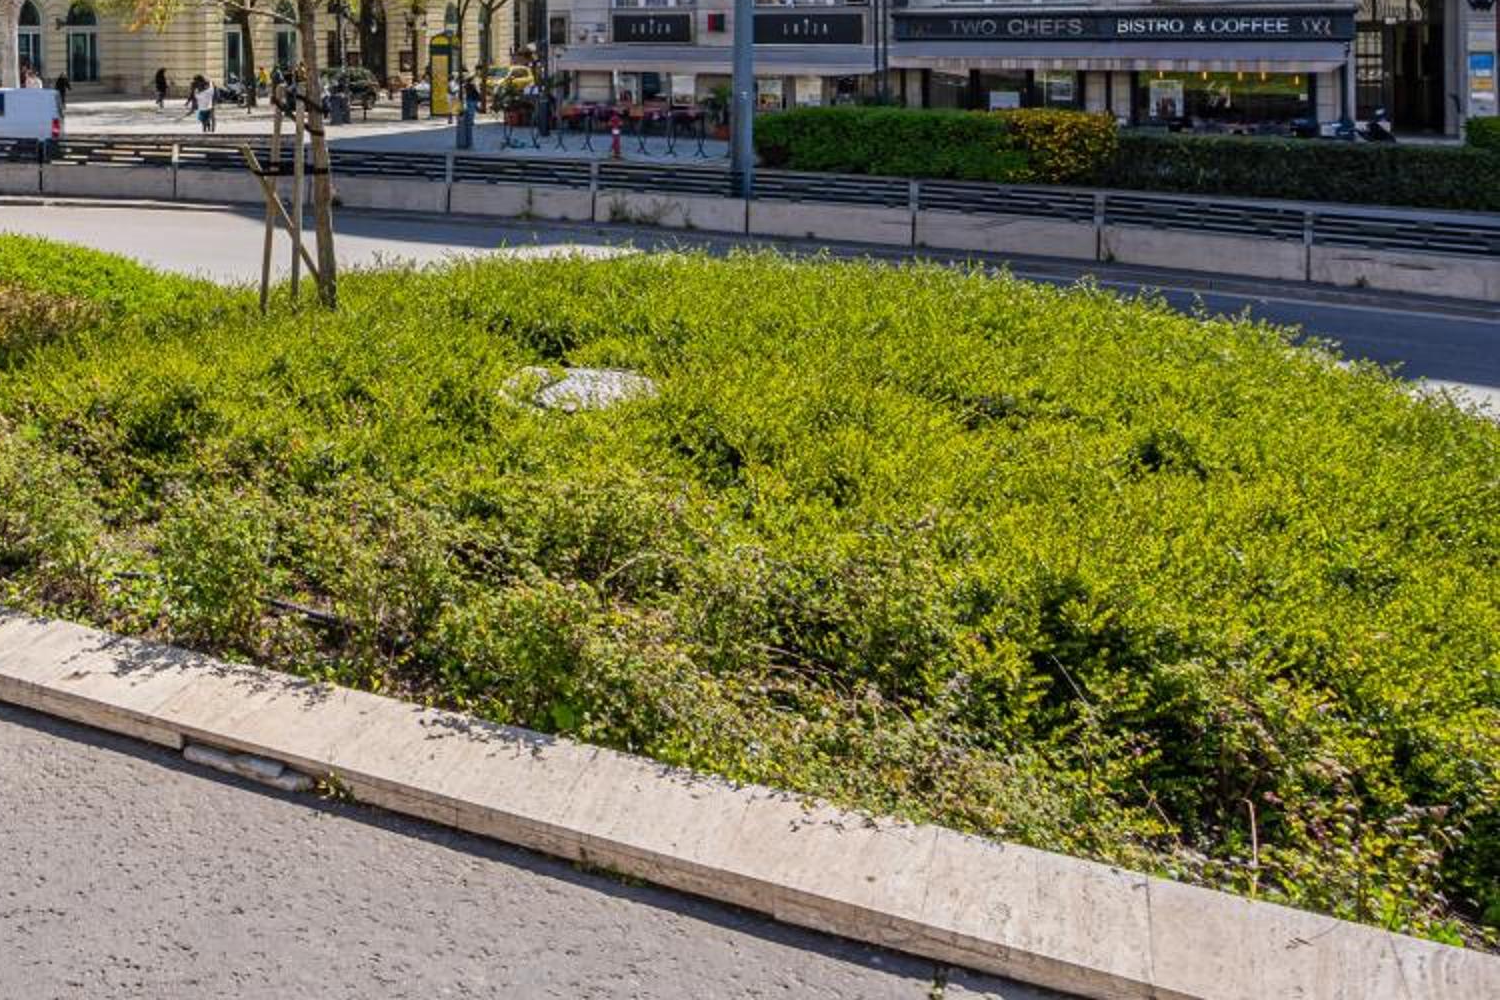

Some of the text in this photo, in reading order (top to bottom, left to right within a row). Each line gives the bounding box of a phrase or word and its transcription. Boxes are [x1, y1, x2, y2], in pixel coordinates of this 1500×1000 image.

[949, 17, 1290, 36] TWO CHEFS BISTRO & COFFEE
